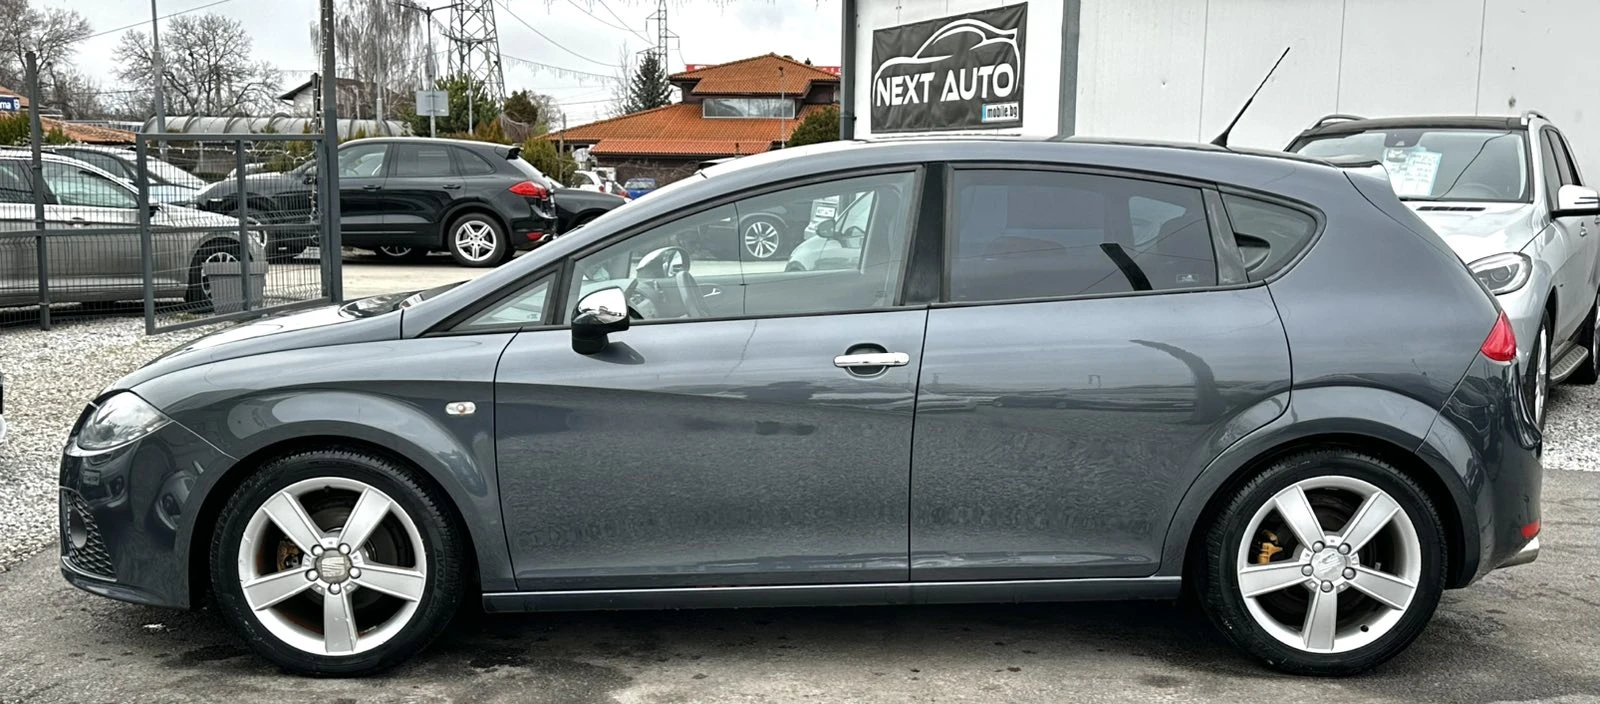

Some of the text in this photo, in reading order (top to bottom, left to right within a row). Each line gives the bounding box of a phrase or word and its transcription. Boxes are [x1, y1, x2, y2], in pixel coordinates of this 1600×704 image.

[877, 63, 1014, 107] NEXT AUTO
[987, 105, 1017, 118] mobile.bg
